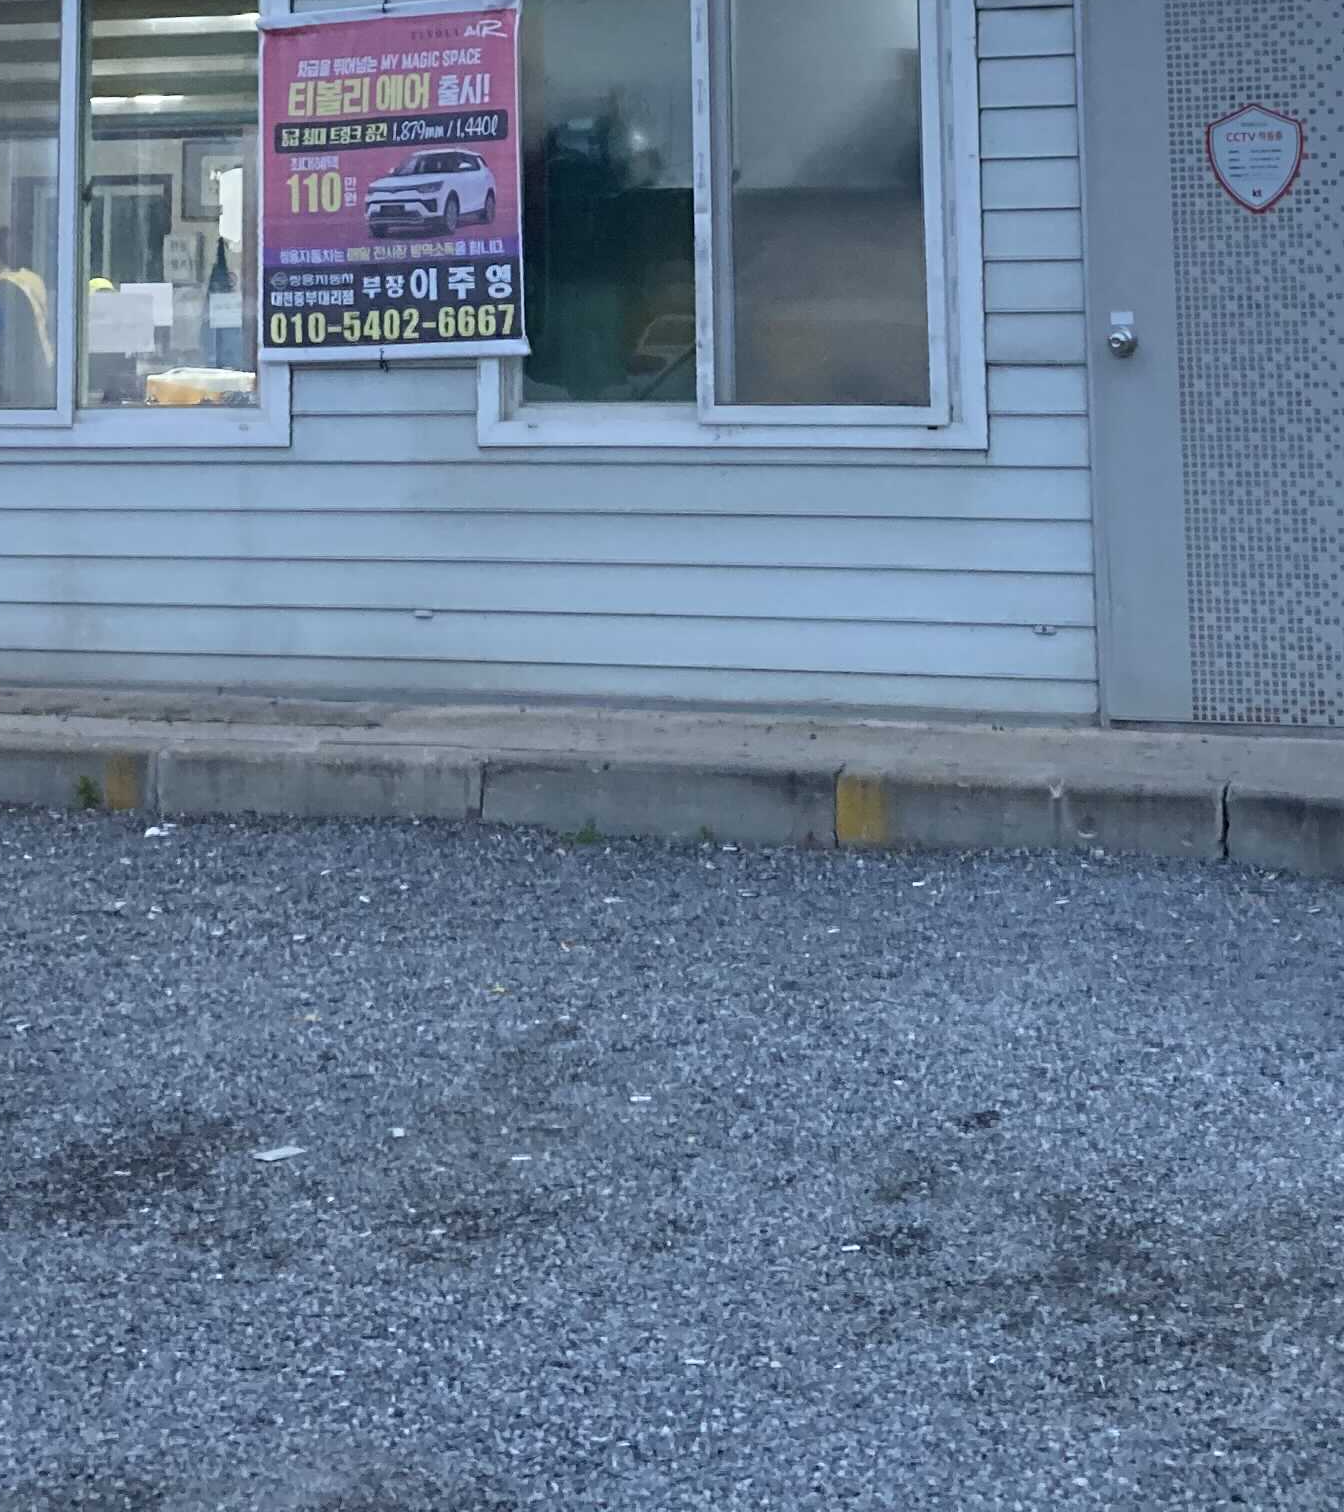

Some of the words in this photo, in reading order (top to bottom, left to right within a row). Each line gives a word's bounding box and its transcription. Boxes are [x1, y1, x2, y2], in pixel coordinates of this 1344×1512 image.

[380, 54, 399, 71] MY
[402, 51, 440, 69] MAGIC
[443, 48, 482, 66] SPACE
[287, 76, 369, 117] 티볼리
[376, 72, 431, 111] 에어
[437, 73, 490, 106] 출시!
[281, 128, 299, 147] 동급
[302, 127, 326, 145] 최대
[329, 125, 362, 144] 트렁크
[365, 122, 388, 142] 공간
[286, 172, 342, 214] 110
[362, 275, 404, 299] 부장
[269, 304, 515, 344] 010-5402-6667
